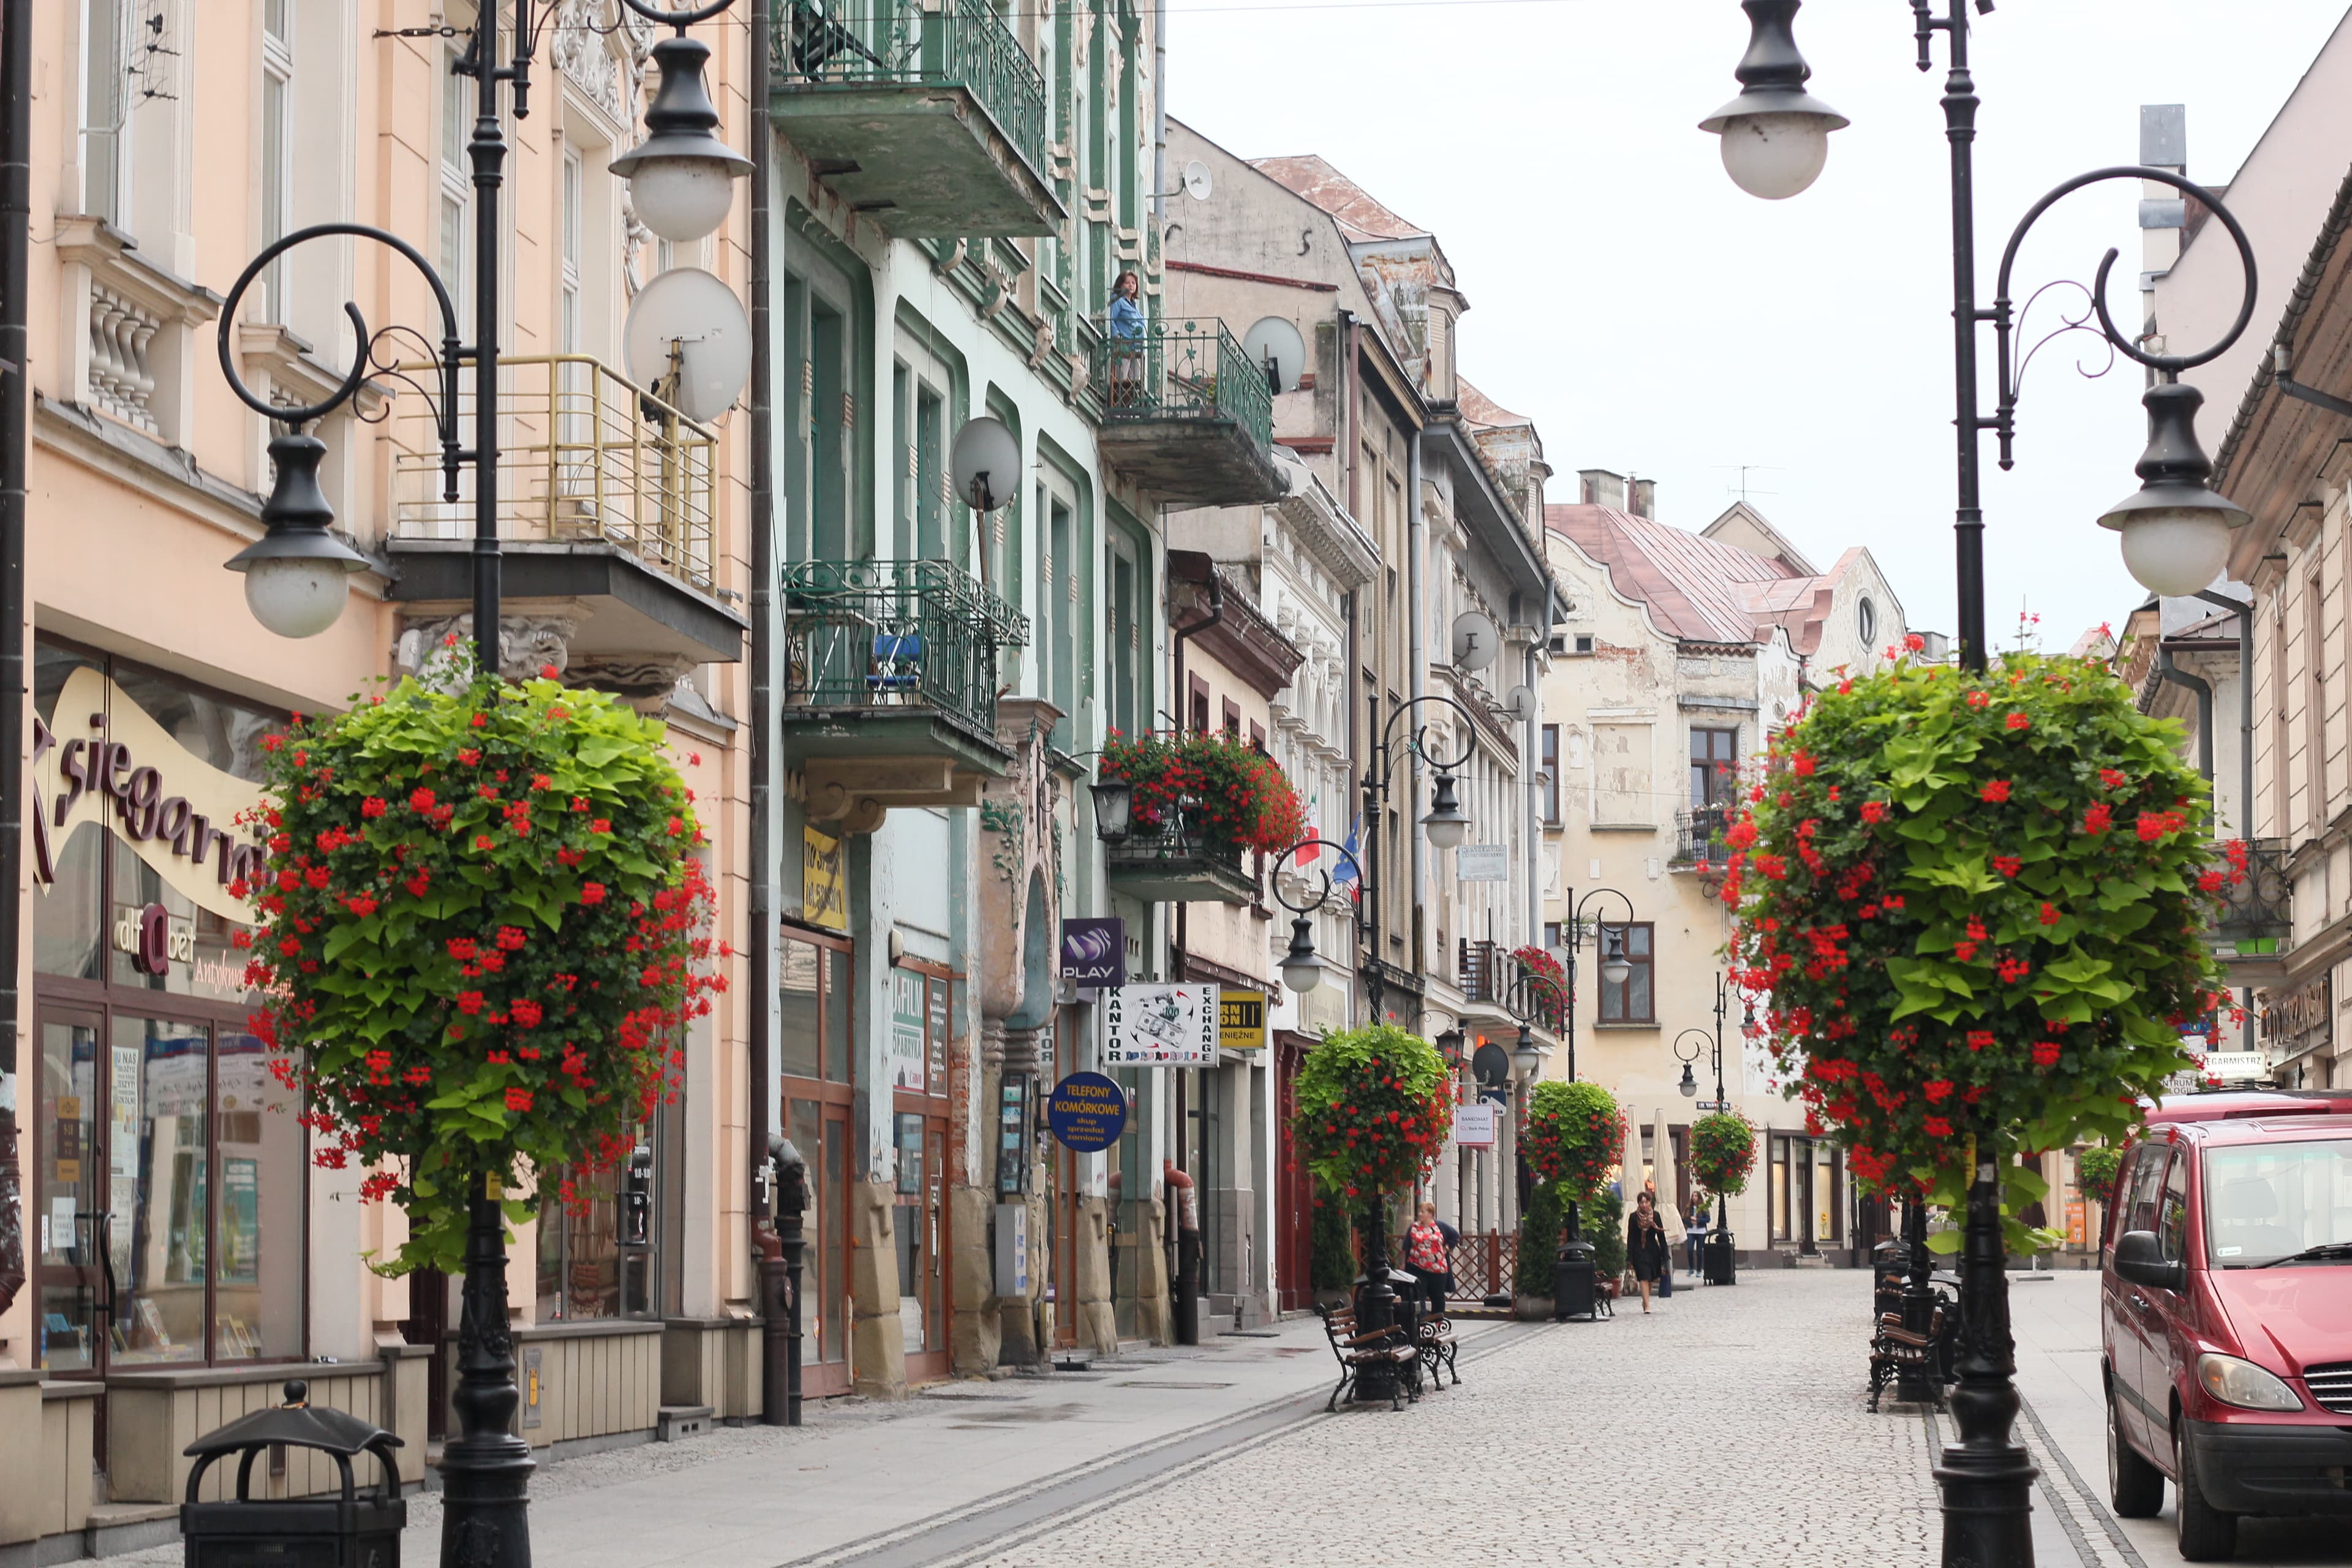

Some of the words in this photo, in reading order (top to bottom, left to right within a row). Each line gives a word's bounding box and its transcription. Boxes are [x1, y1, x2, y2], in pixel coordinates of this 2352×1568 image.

[34, 713, 277, 895] Księgarni
[1063, 967, 1114, 979] PLAY
[1108, 986, 1122, 1061] KANTOR
[1201, 987, 1212, 1061] EXCHANGE
[123, 1052, 137, 1065] NAS
[1066, 1085, 1110, 1098] TELEFONY
[1055, 1099, 1120, 1115] KOMÓRKOWE
[1067, 1125, 1105, 1134] sprzedaż
